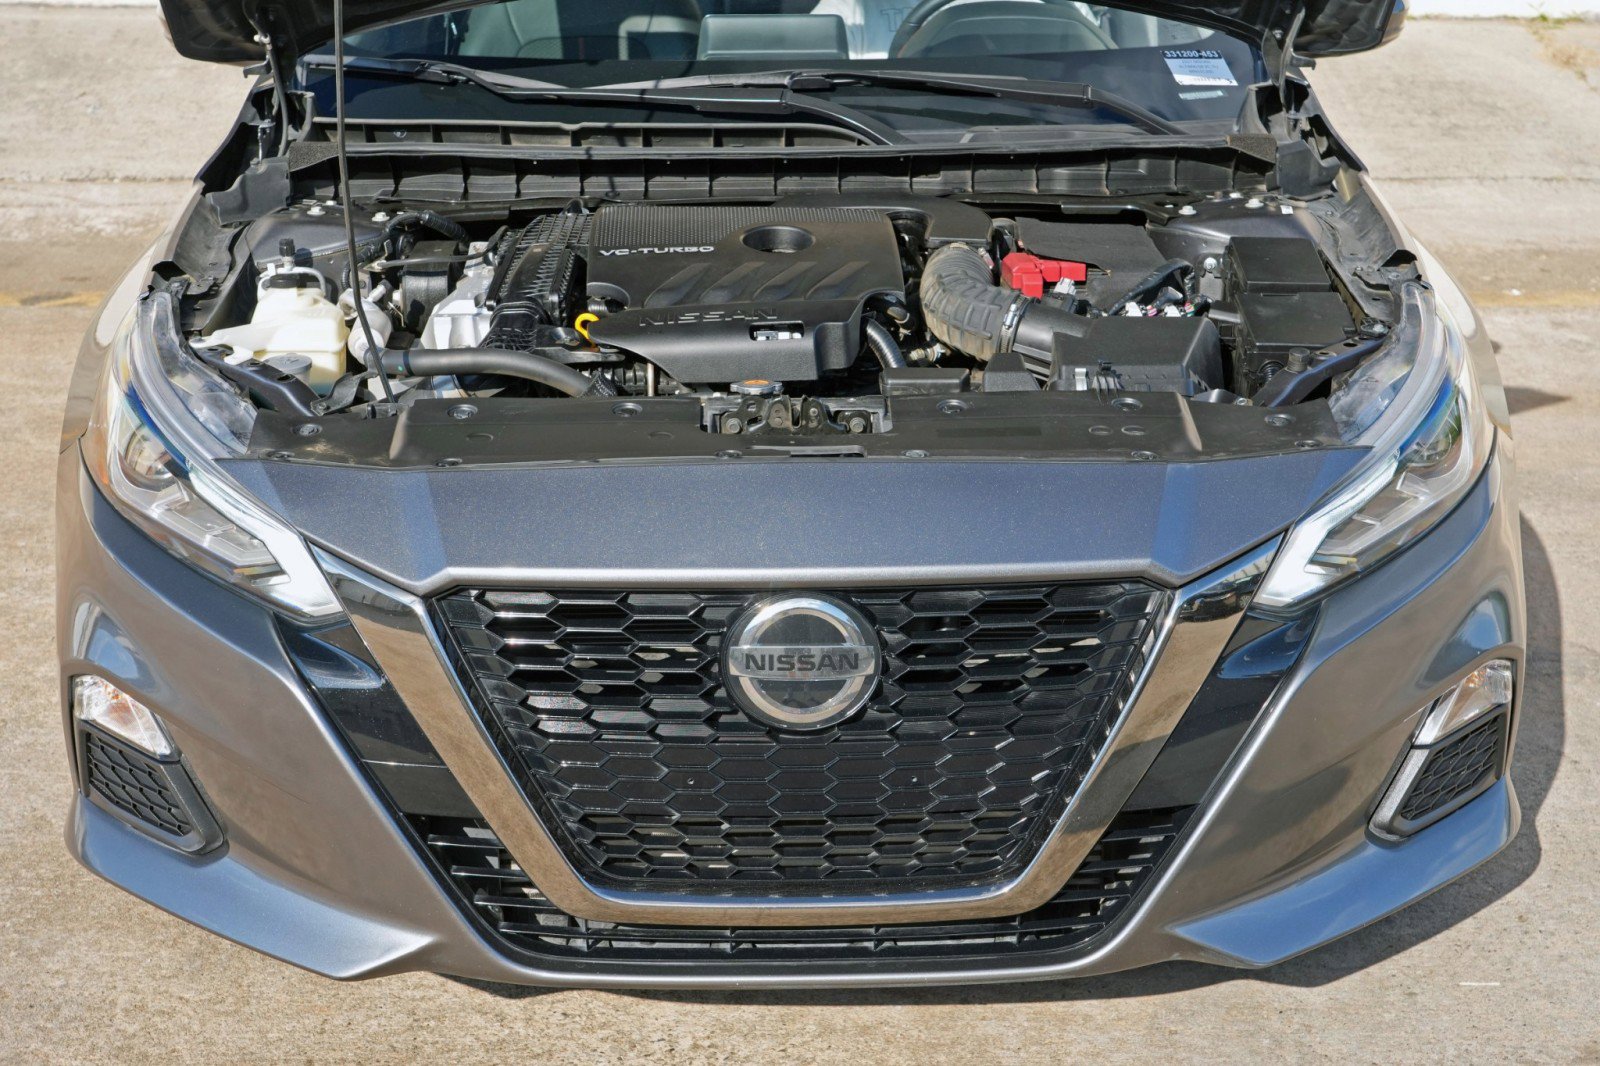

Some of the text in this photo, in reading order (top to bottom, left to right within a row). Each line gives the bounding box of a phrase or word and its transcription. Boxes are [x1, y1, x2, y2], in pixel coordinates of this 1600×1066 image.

[1164, 50, 1219, 58] 331200-453
[599, 246, 715, 256] VC-TURBO
[639, 306, 778, 327] NISSAN
[745, 652, 860, 672] NISSAN
